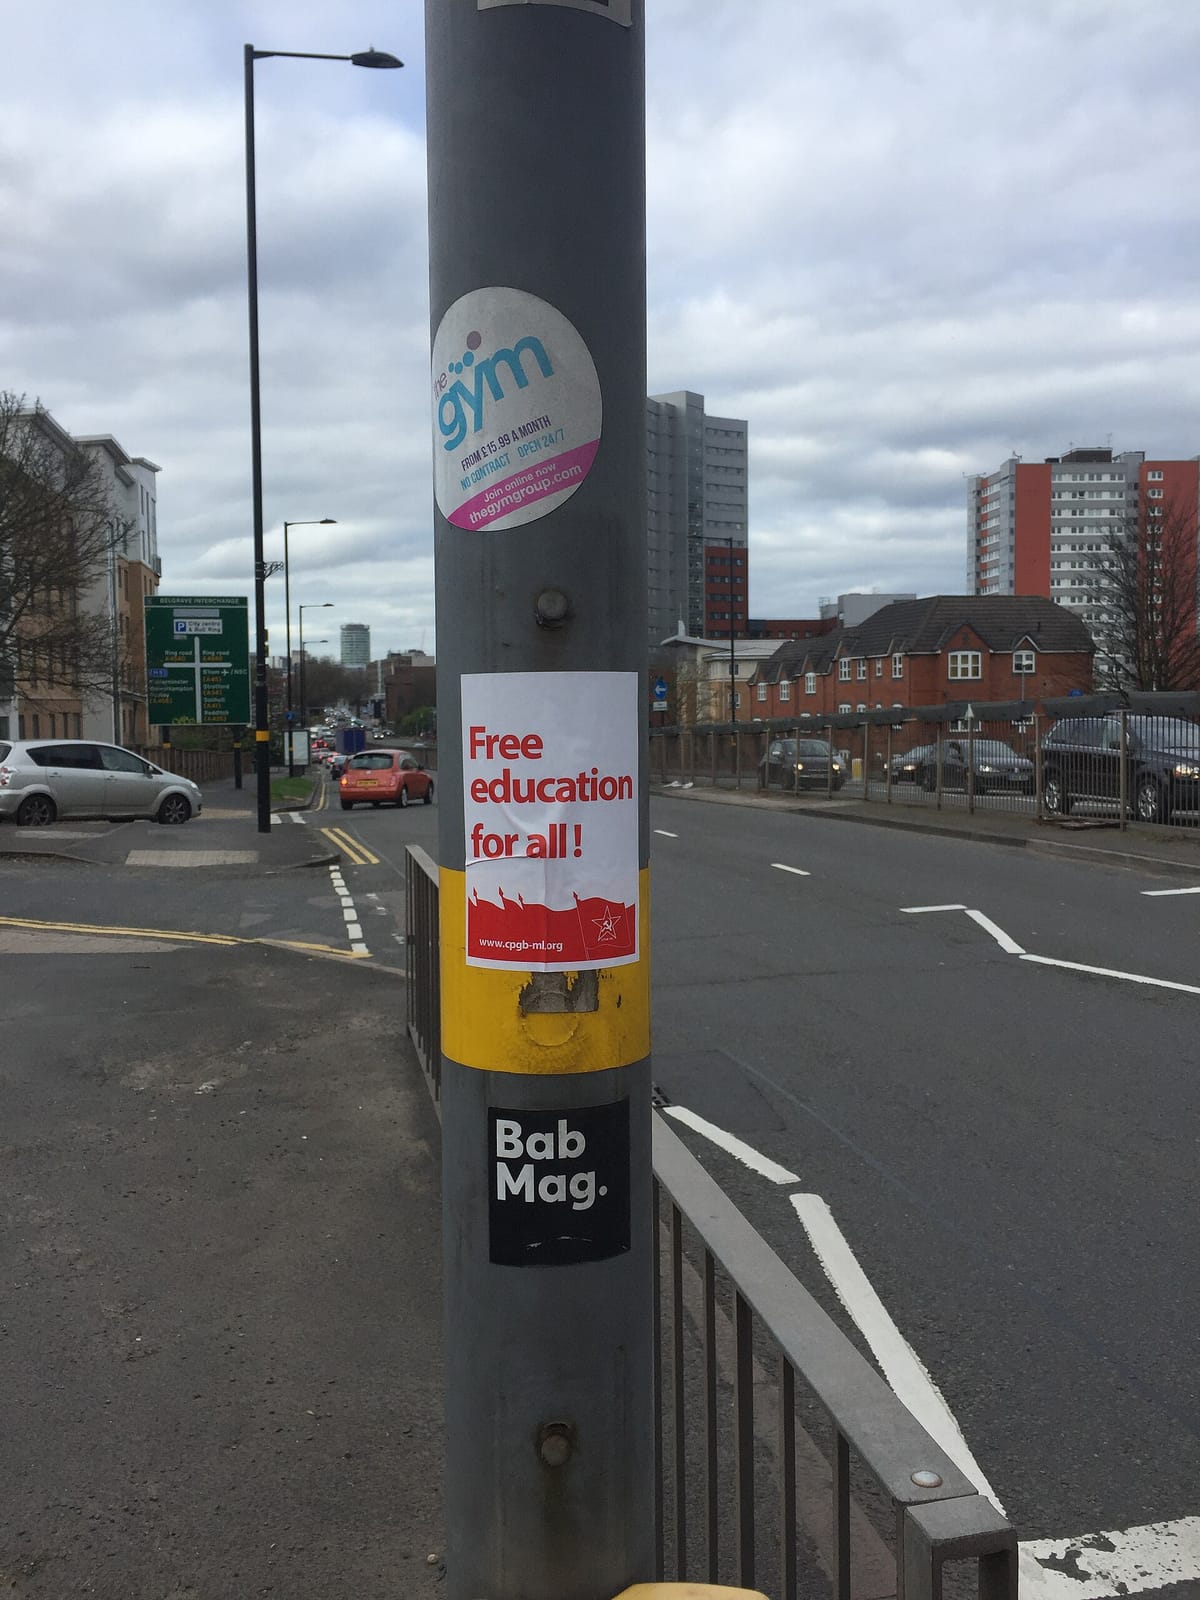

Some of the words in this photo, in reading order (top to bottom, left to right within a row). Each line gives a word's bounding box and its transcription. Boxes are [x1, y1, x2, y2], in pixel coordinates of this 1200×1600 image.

[433, 372, 448, 400] the
[438, 335, 554, 452] gym
[461, 451, 481, 471] FROM
[481, 436, 510, 459] £15.99
[512, 430, 519, 442] A
[518, 415, 551, 438] MONTH
[461, 477, 471, 490] NO
[471, 453, 511, 485] CONTRACT
[518, 441, 541, 458] OPEN
[541, 428, 565, 449] 24/7
[469, 463, 583, 524] thegymgroup.com
[483, 488, 504, 503] Join
[505, 472, 534, 492] online
[535, 463, 557, 478] now
[469, 726, 544, 760] Free
[470, 767, 633, 804] education
[471, 823, 519, 858] for
[479, 937, 564, 952] www.cpgb-ml.org
[496, 1119, 586, 1160] Bab
[496, 1162, 608, 1211] Mag.
